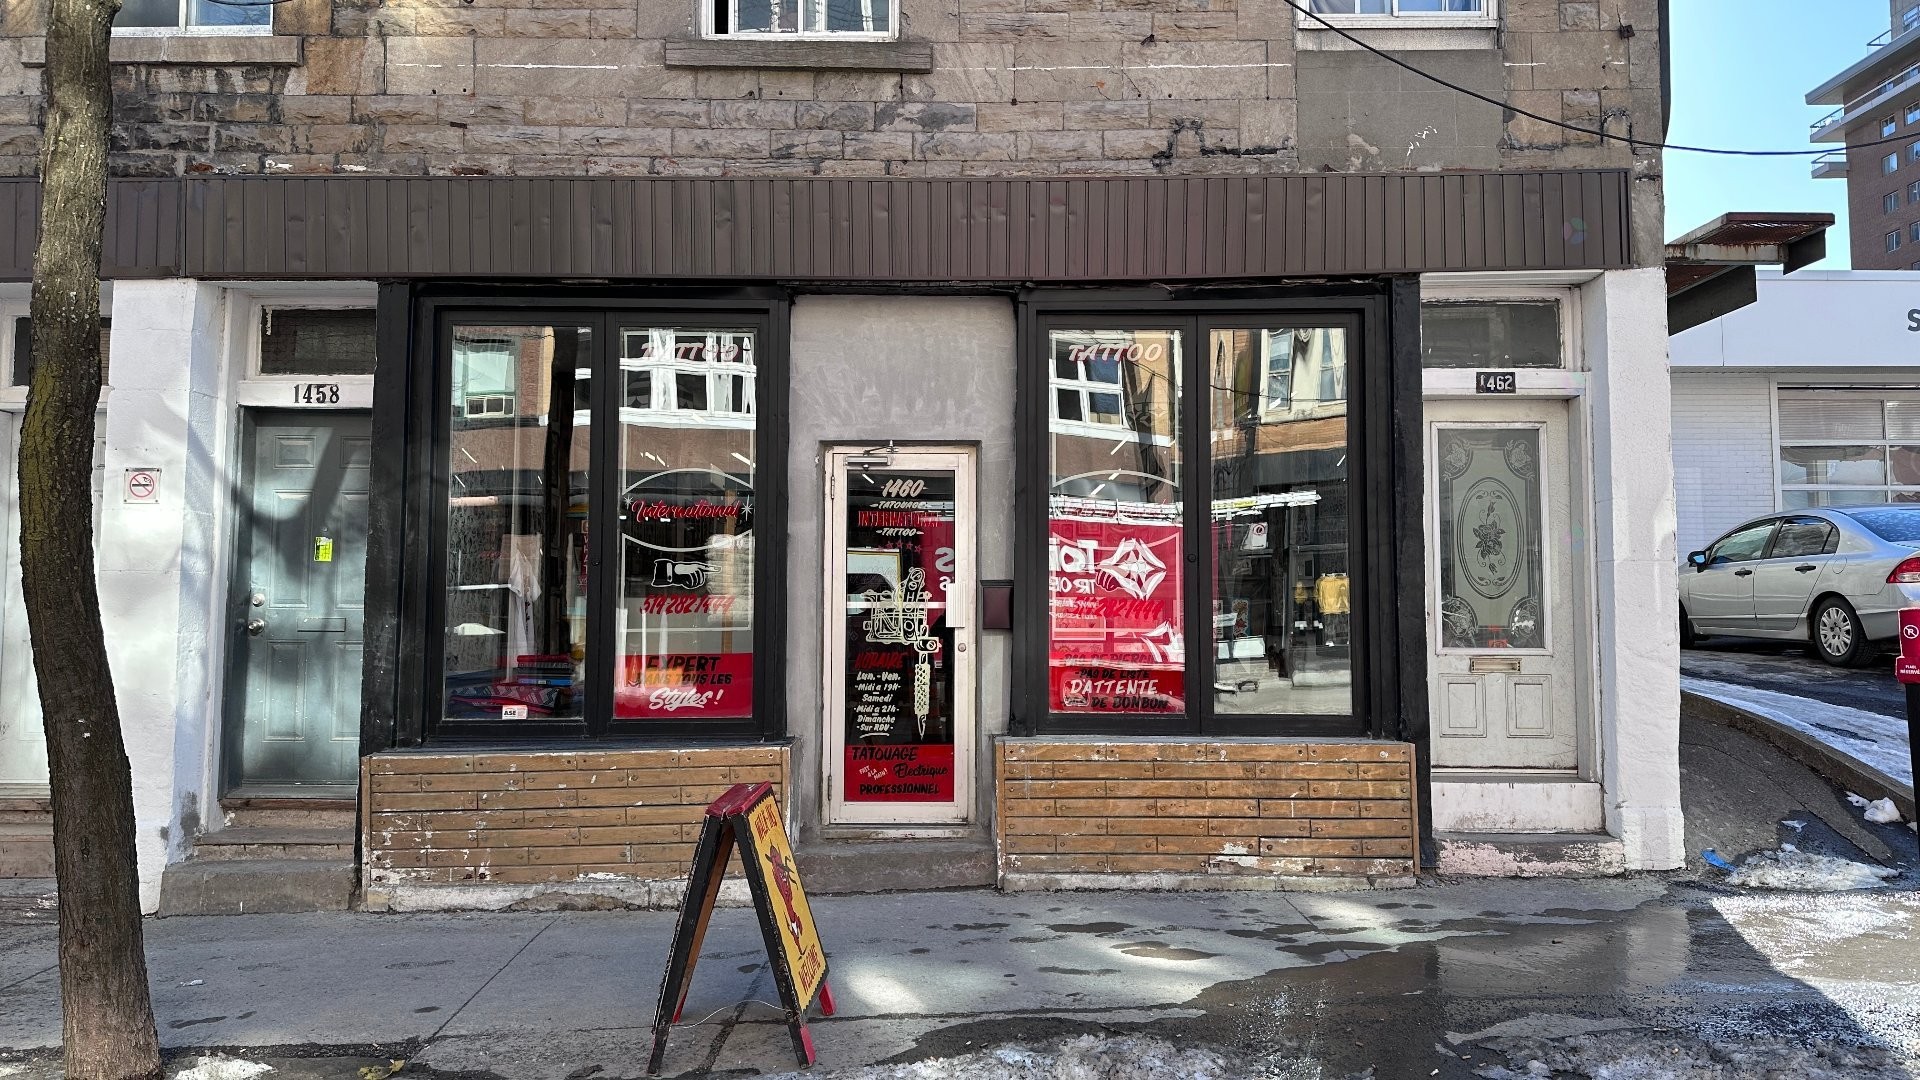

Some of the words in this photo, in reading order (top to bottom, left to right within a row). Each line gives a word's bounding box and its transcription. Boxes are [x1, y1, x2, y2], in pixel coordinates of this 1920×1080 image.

[641, 342, 739, 361] TTTOO
[1068, 343, 1163, 362] TATTOO
[1480, 374, 1513, 391] 1462
[293, 383, 340, 404] 1458
[631, 499, 741, 523] International
[646, 655, 722, 672] EXPERT
[855, 651, 908, 670] HORAIRE
[709, 674, 733, 685] LES
[1101, 668, 1115, 679] DE
[1119, 669, 1150, 679] LISTE
[1070, 679, 1159, 695] D'ATTENTE
[862, 693, 894, 703] Samedi
[1090, 697, 1108, 709] DE
[1112, 695, 1169, 709] BONBON
[856, 714, 896, 724] Dimanche
[851, 746, 919, 762] TATOUAGE
[859, 783, 940, 796] PROFESSIONNEL
